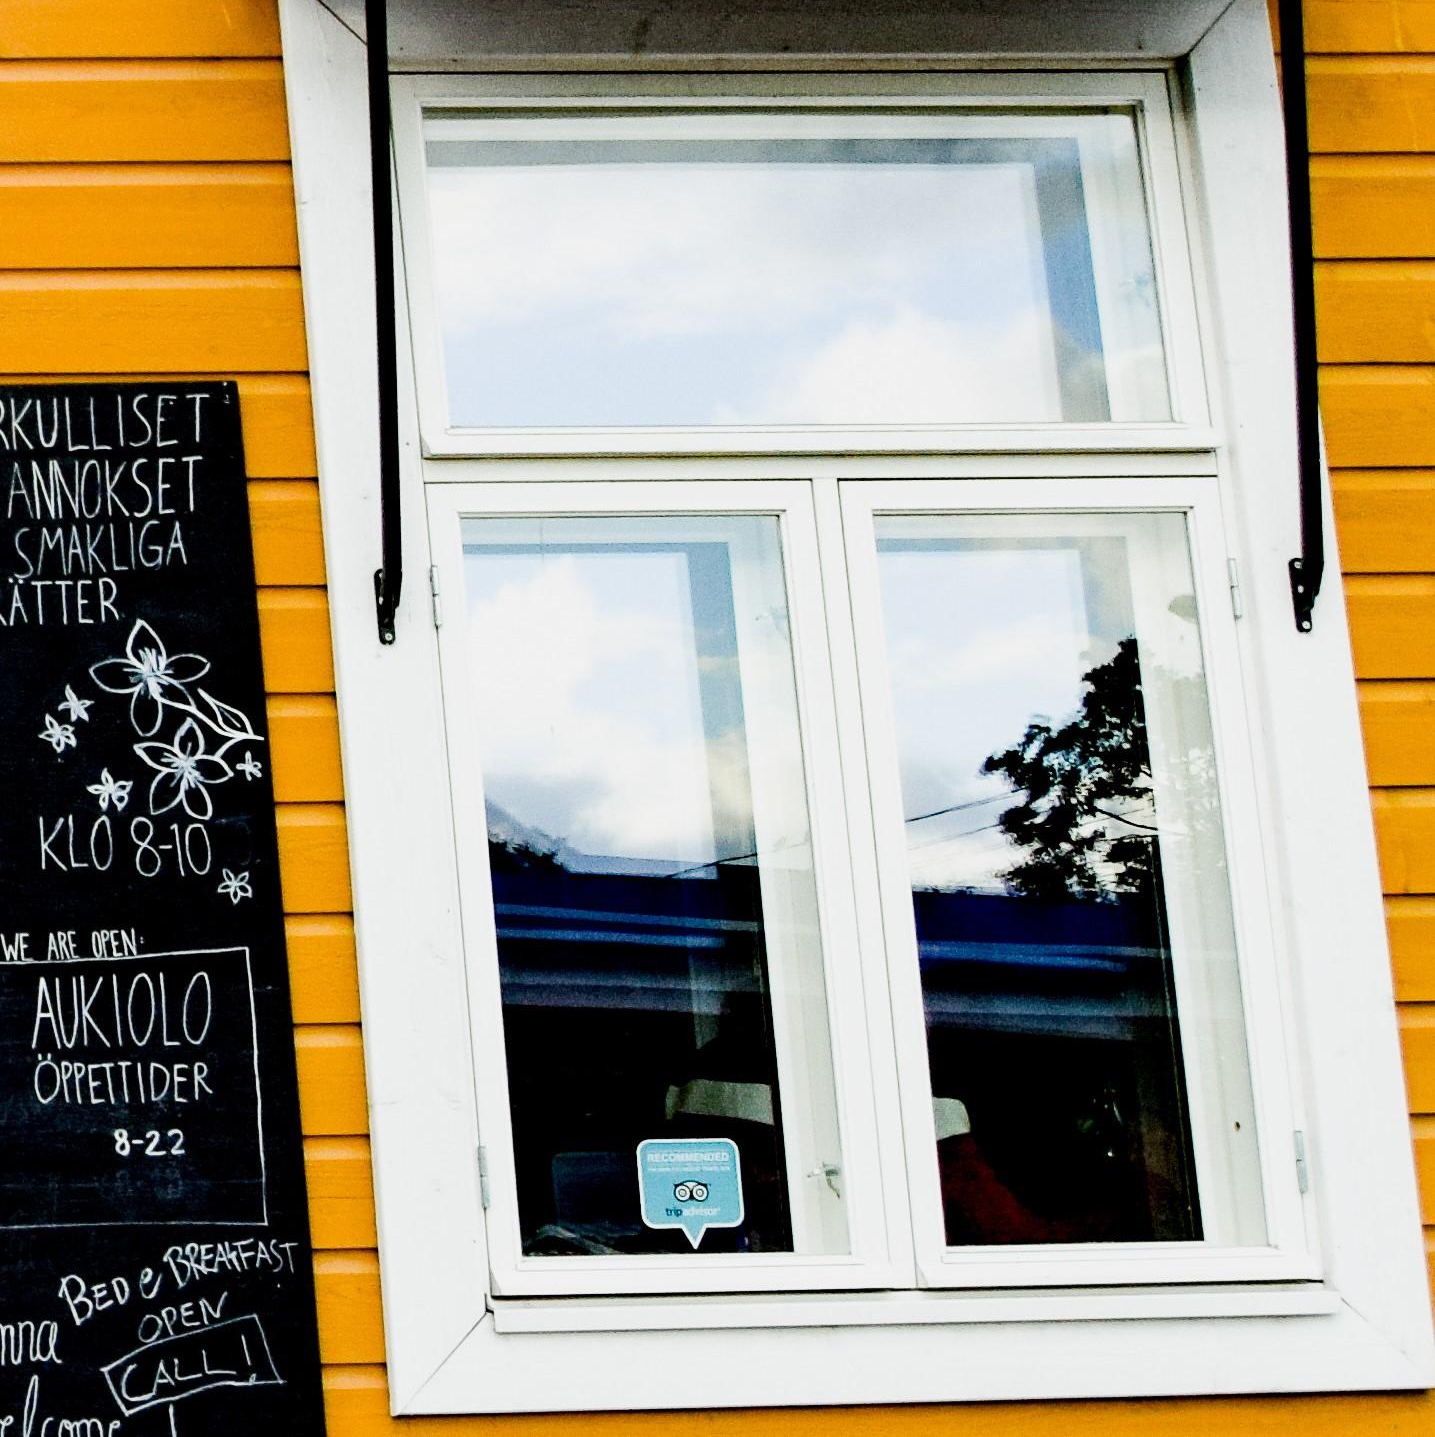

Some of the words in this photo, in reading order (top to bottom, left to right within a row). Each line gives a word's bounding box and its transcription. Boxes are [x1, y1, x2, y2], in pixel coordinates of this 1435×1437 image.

[8, 455, 203, 519] ANNOKSET
[14, 520, 188, 583] SMAKLIGA
[39, 814, 113, 871] KLO
[131, 815, 212, 877] 8-10
[0, 932, 31, 962] WE
[47, 931, 79, 960] ARE
[91, 927, 145, 958] OPEN:
[31, 970, 212, 1050] AUKIOLO
[34, 1052, 213, 1104] ÖPPETTIDER
[113, 1128, 185, 1157] 8-22
[58, 1274, 130, 1326] BED
[162, 1237, 298, 1290] BREAKFAST
[137, 1290, 228, 1343] OPEN
